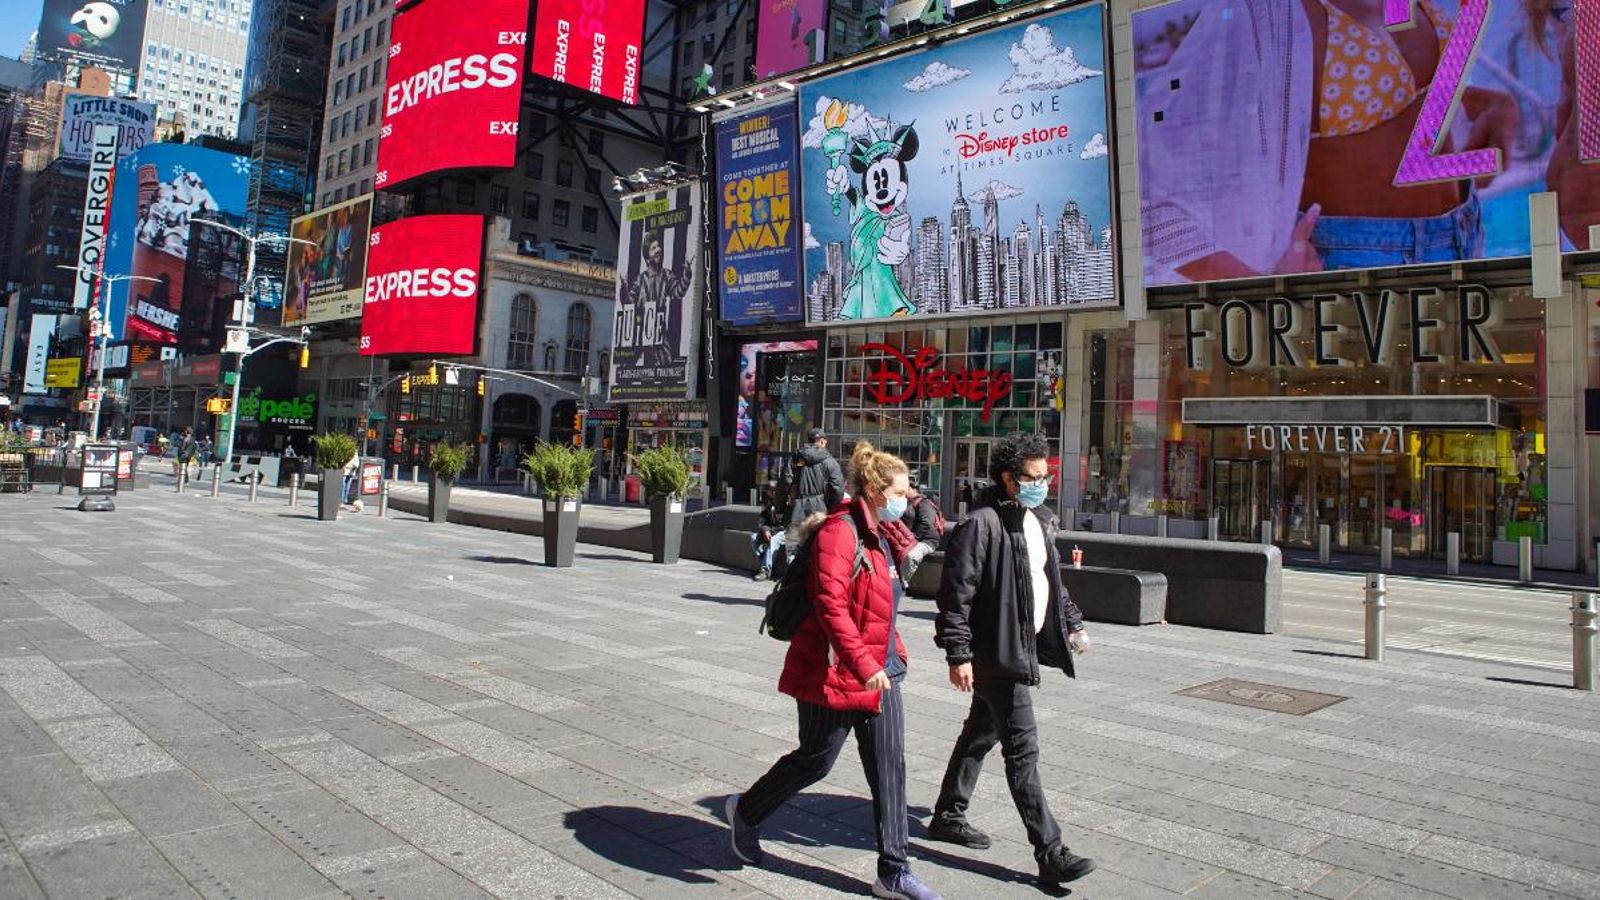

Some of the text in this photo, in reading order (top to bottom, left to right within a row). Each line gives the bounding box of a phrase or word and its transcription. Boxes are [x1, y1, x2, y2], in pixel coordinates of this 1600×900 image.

[386, 53, 518, 117] EXPRESS
[73, 99, 117, 116] LITTLE
[119, 103, 149, 125] SHOP
[945, 95, 1060, 133] WELCOME
[69, 117, 146, 153] HOORS
[1021, 124, 1068, 146] store
[723, 160, 789, 181] COME TOGETHER AT
[941, 143, 1074, 175] AT TIMES SQUARE
[723, 169, 790, 205] COME
[80, 134, 116, 284] COVERGIRL
[724, 220, 791, 255] AWAY
[364, 267, 477, 304] EXPRESS
[1184, 284, 1500, 371] FOREVER
[1246, 424, 1405, 455] FOREVER 21
